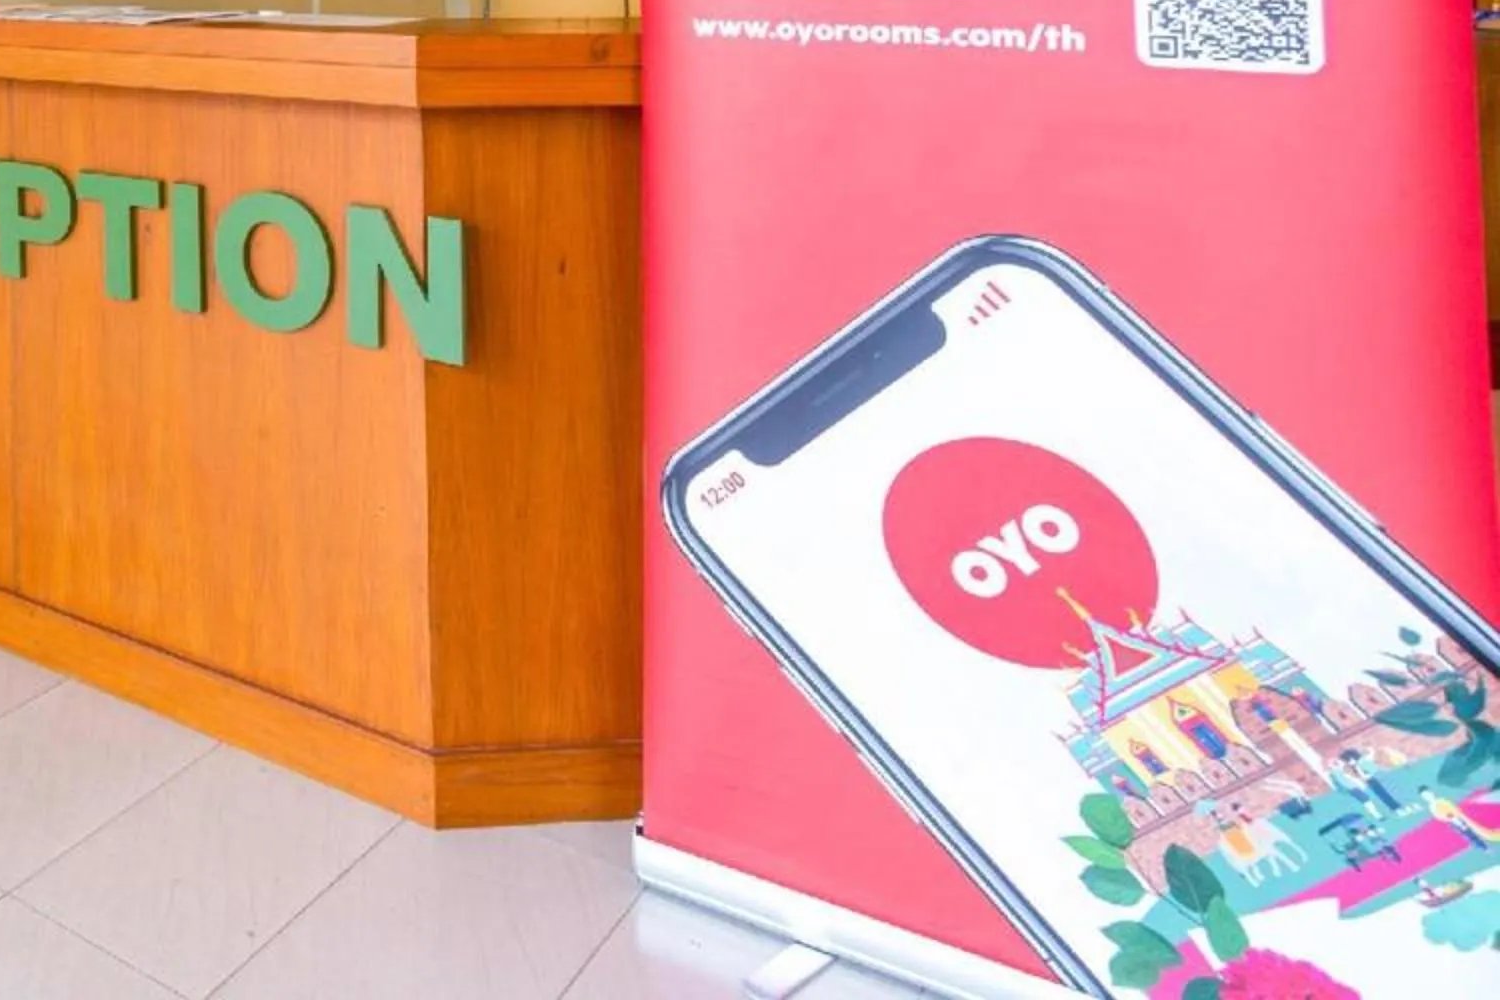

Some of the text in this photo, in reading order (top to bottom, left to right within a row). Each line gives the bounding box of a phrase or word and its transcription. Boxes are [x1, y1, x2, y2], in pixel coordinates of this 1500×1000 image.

[692, 17, 1086, 53] www.oyorooms.com/th
[700, 471, 745, 510] 12:00
[950, 503, 1081, 599] OYO
